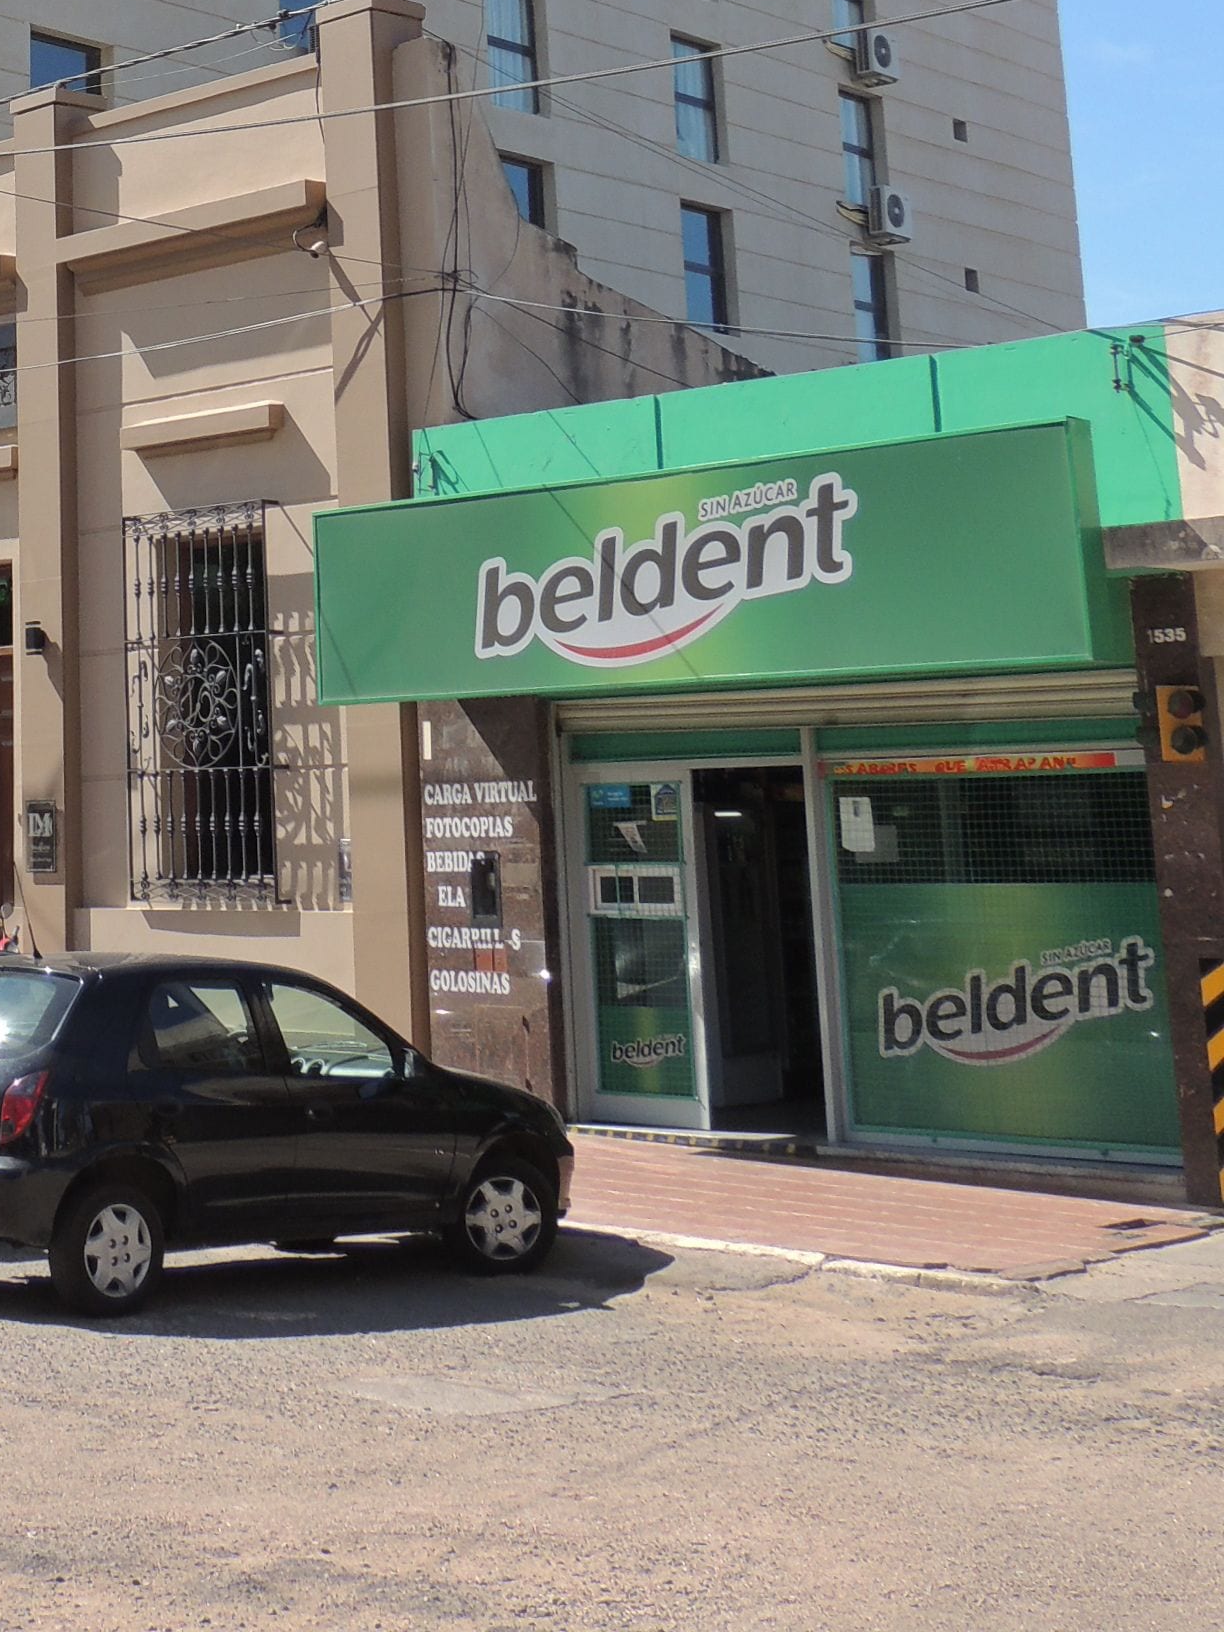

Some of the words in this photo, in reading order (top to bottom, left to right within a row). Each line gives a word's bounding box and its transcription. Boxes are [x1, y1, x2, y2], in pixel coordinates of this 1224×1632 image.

[700, 498, 726, 517] SIN
[730, 481, 795, 509] AZÚCAR
[480, 481, 850, 651] beldent
[1146, 627, 1187, 644] 1535
[424, 783, 473, 805] CARGA
[474, 780, 537, 803] VIRTUAL
[425, 816, 514, 838] FOTOCOPIAS
[426, 926, 521, 951] CIGARRILLS
[430, 969, 511, 995] GOLOSINAS
[881, 941, 1150, 1052] beldent
[612, 1035, 685, 1061] beldent
